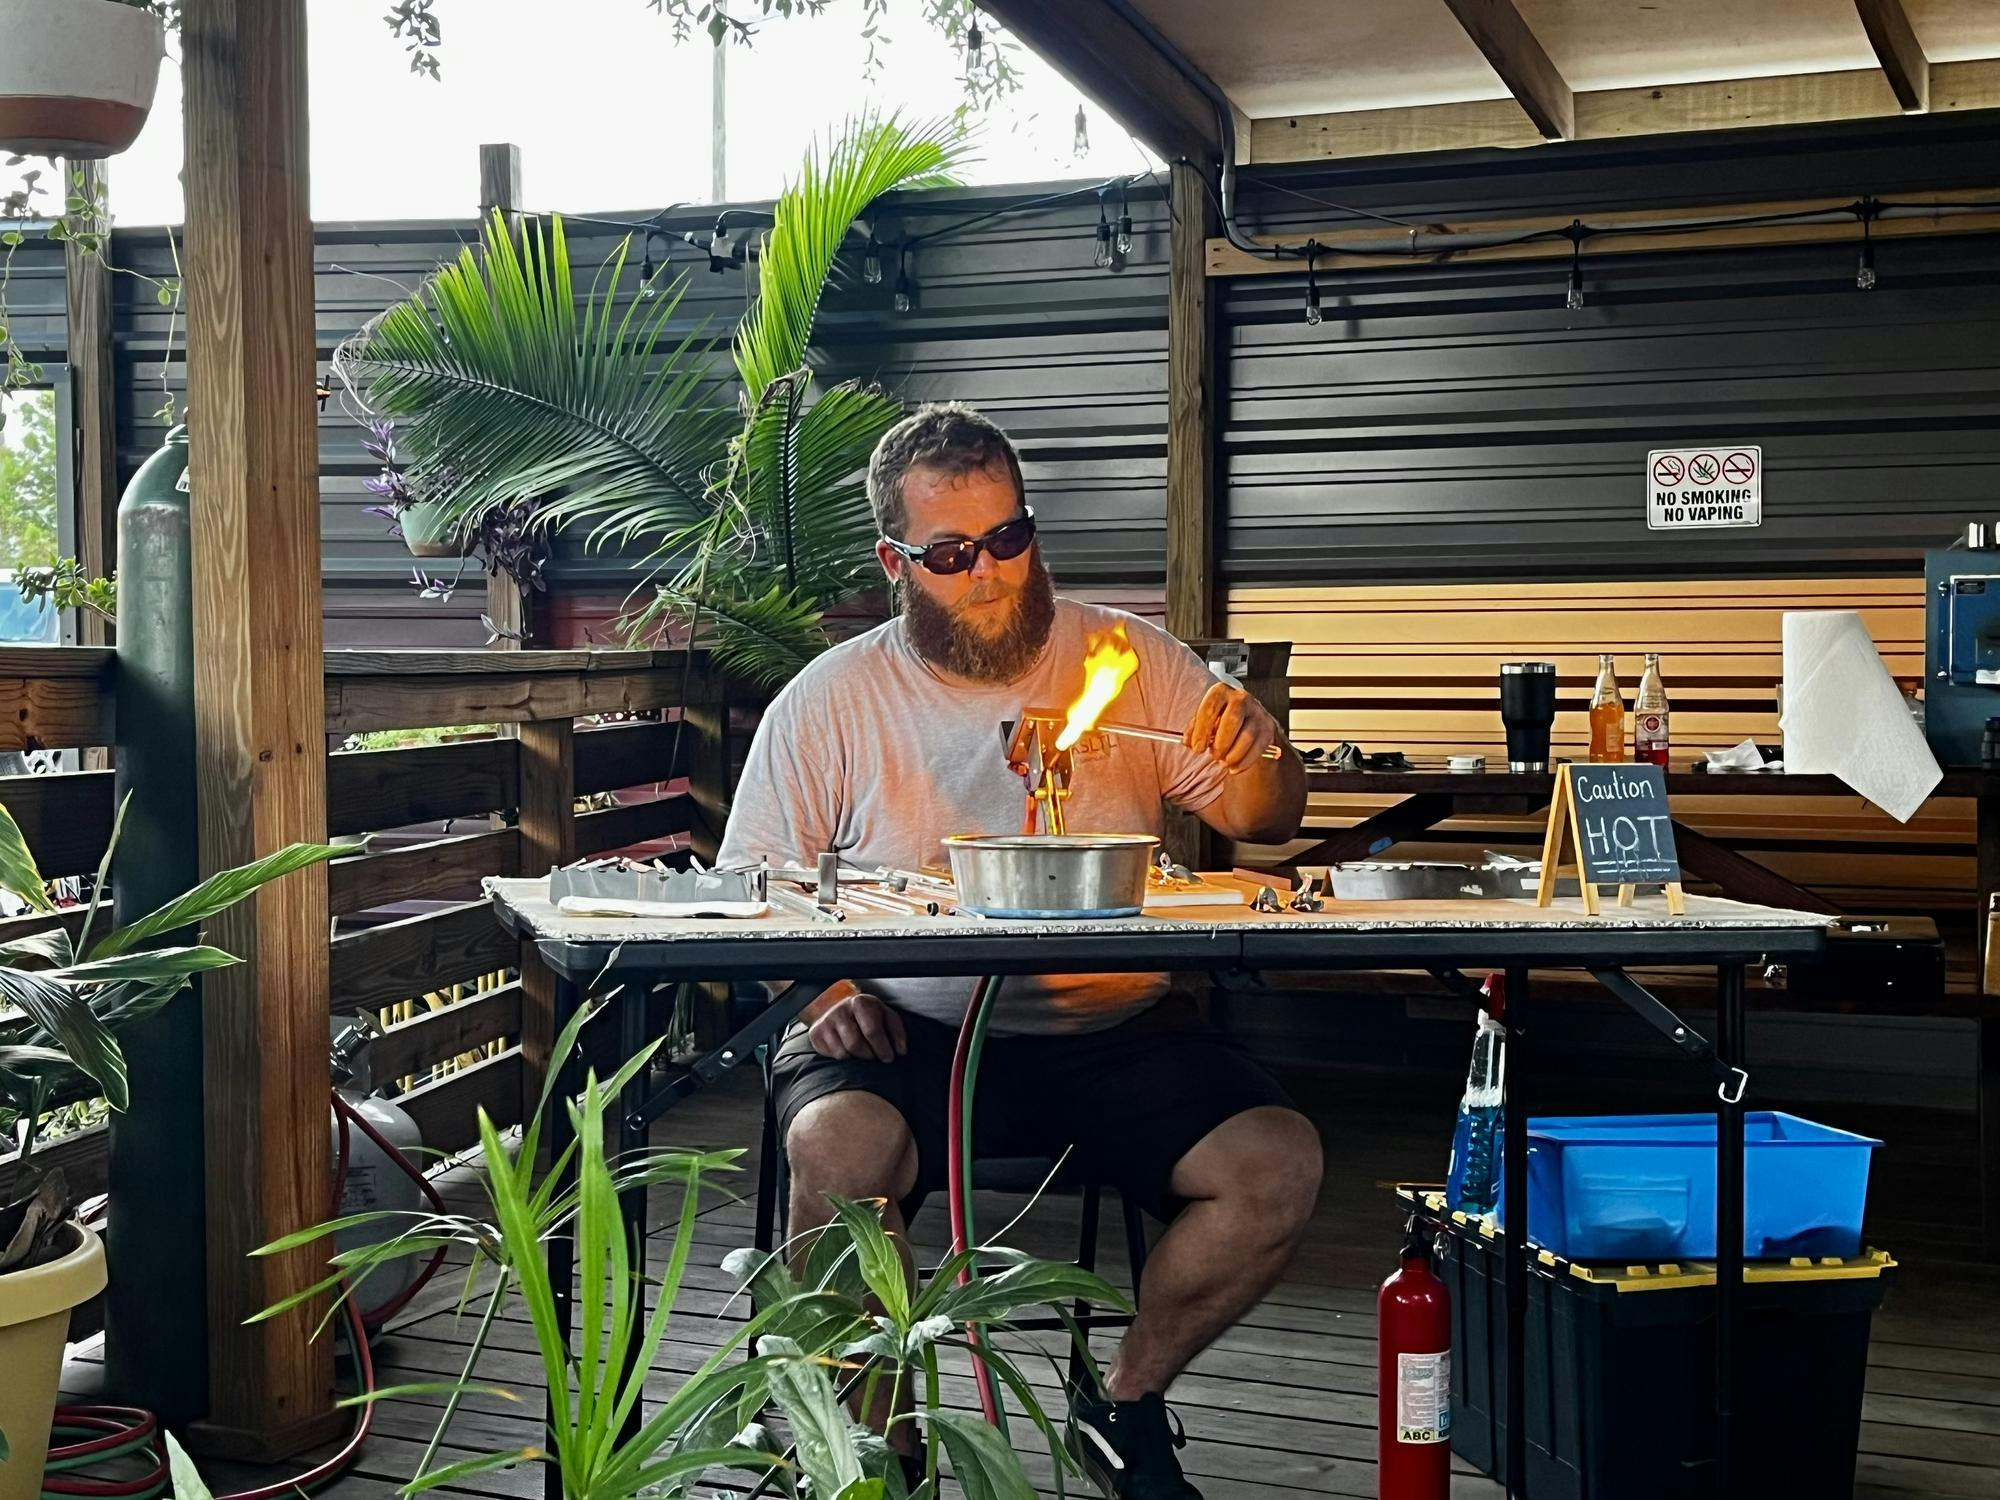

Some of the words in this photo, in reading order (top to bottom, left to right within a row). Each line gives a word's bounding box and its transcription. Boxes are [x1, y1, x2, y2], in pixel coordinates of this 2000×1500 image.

[1657, 493, 1676, 505] NO
[1681, 489, 1751, 504] SMOKING
[1664, 508, 1684, 521] NO
[1688, 506, 1743, 520] VAPING
[1577, 770, 1655, 802] Caution
[1585, 816, 1668, 860] HOT
[1403, 1431, 1431, 1440] ABC
